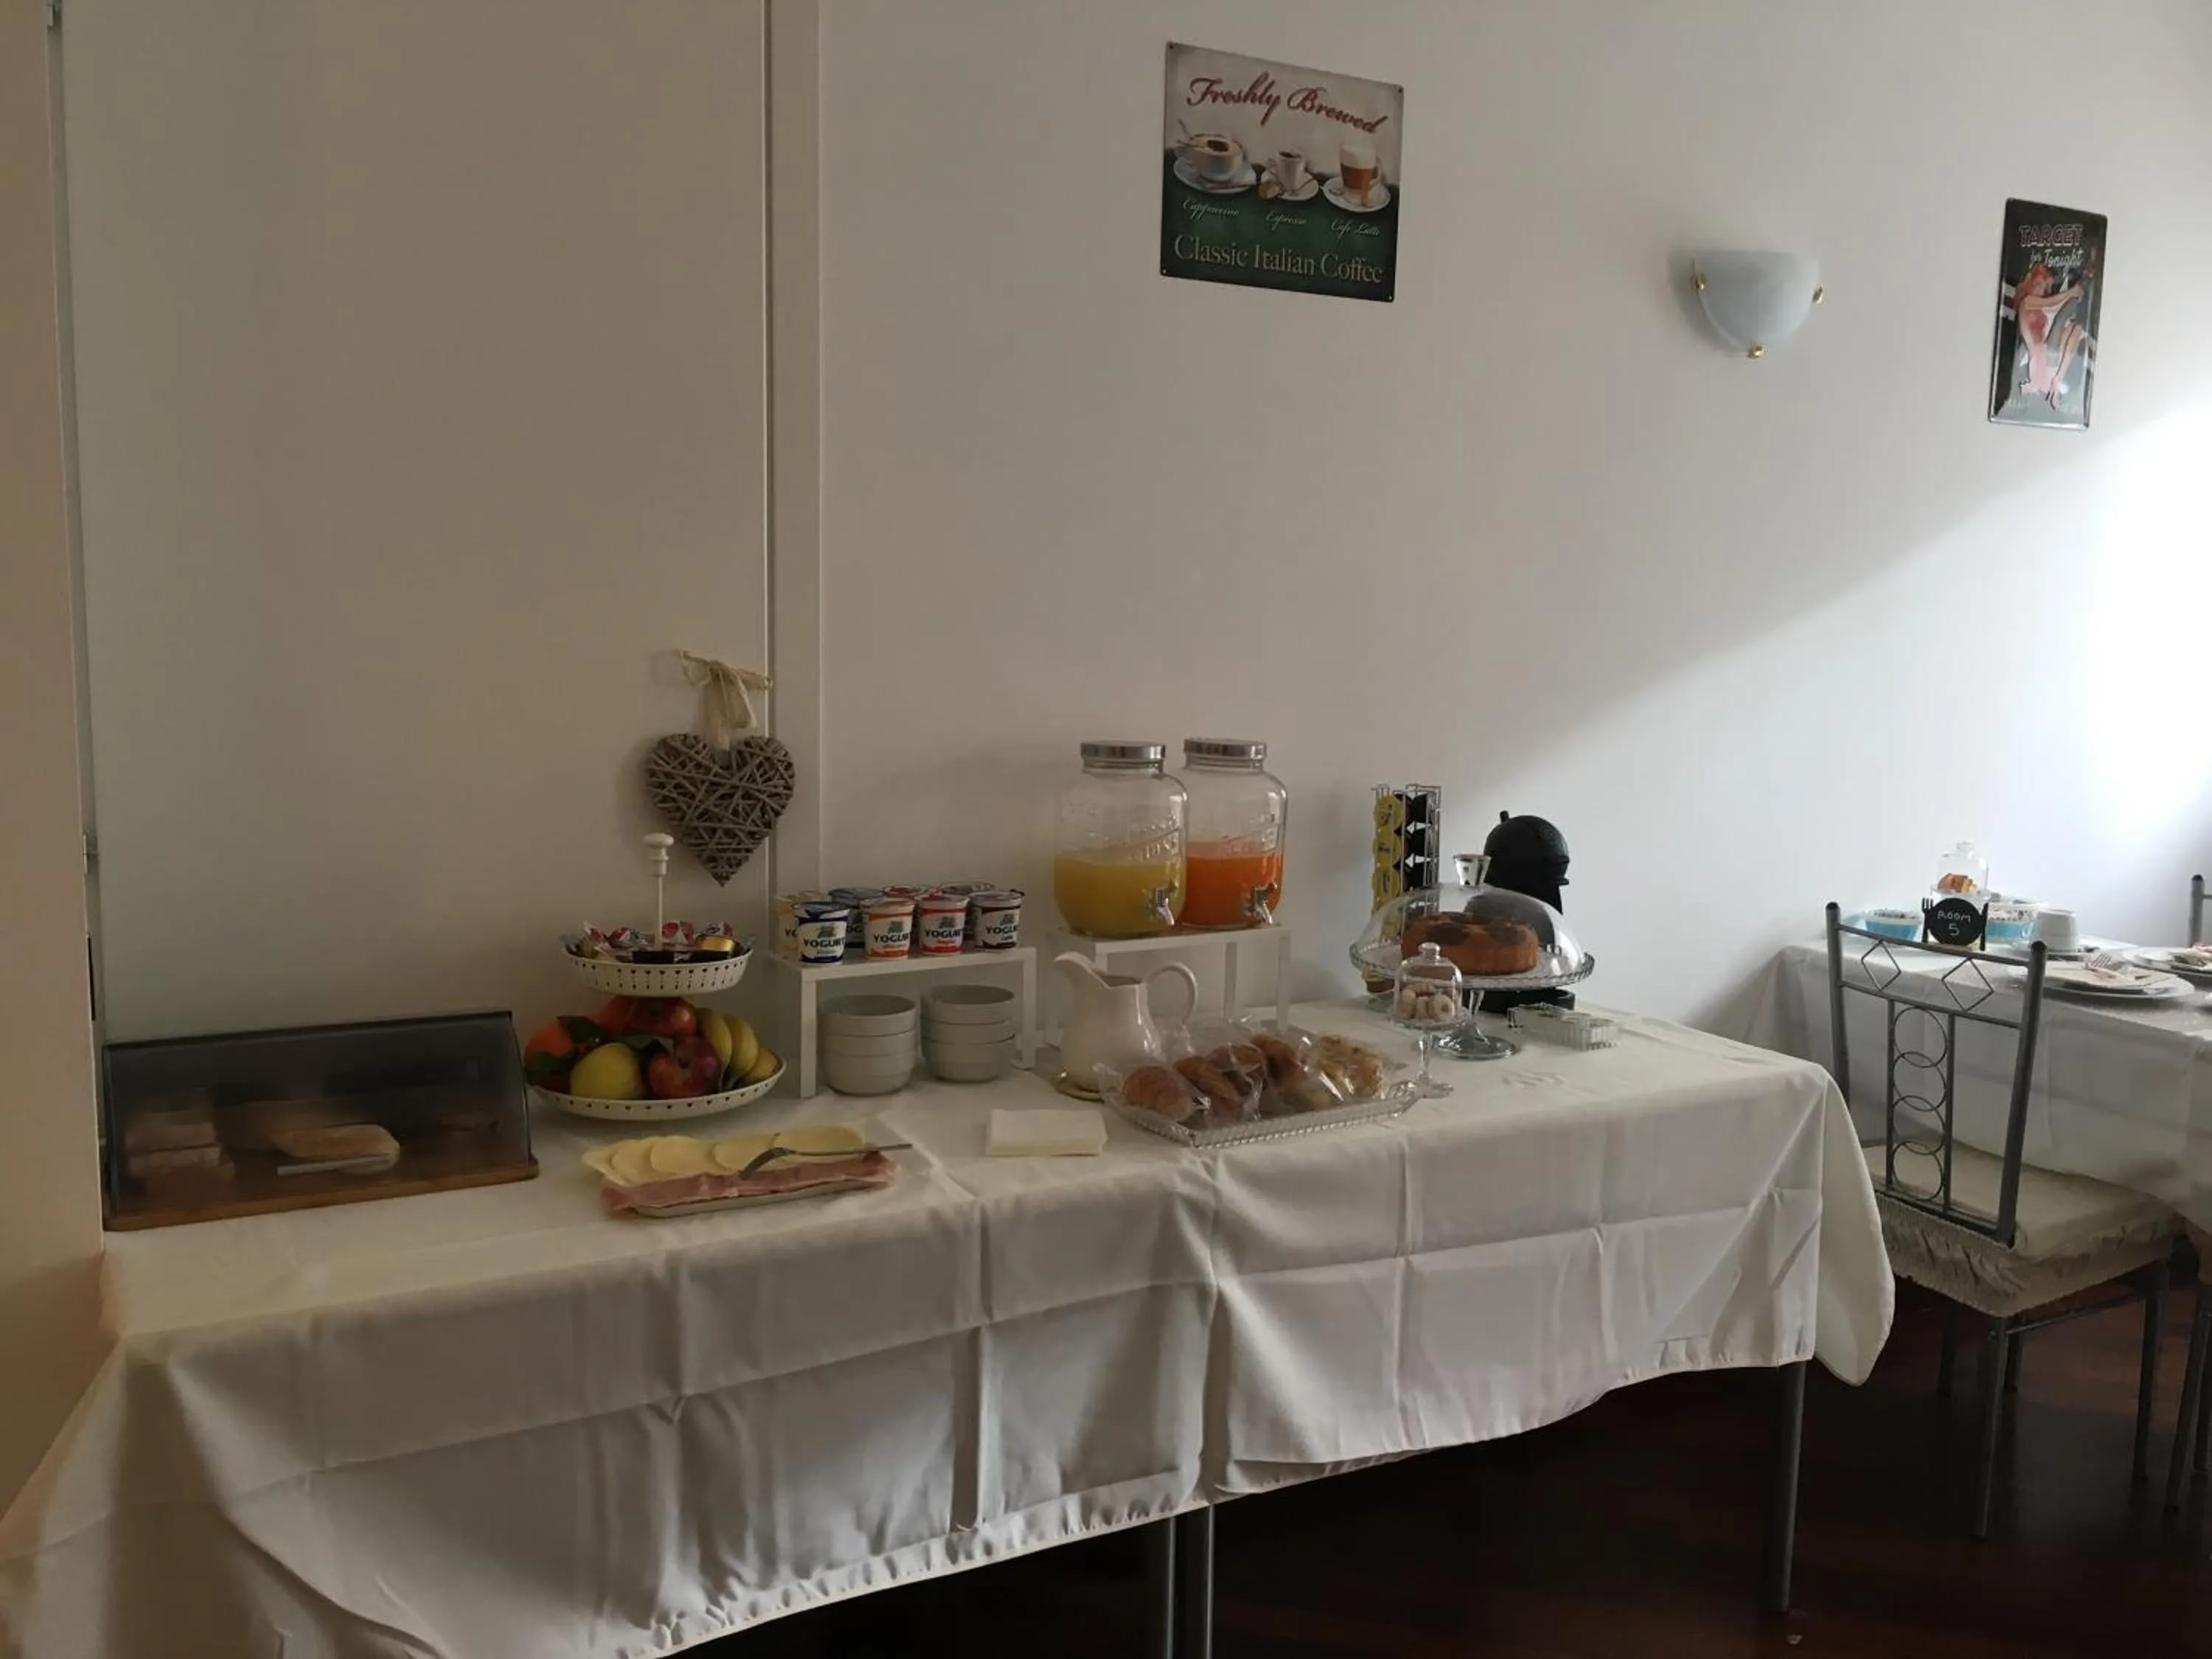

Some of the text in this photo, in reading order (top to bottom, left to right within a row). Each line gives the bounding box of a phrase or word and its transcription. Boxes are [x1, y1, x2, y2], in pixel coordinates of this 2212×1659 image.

[1187, 72, 1388, 133] Freshly Brewed
[2018, 223, 2084, 247] TARGET
[1175, 233, 1383, 283] Classic Italian Coffee
[2044, 248, 2084, 274] Tonight
[1949, 922, 1959, 936] 5
